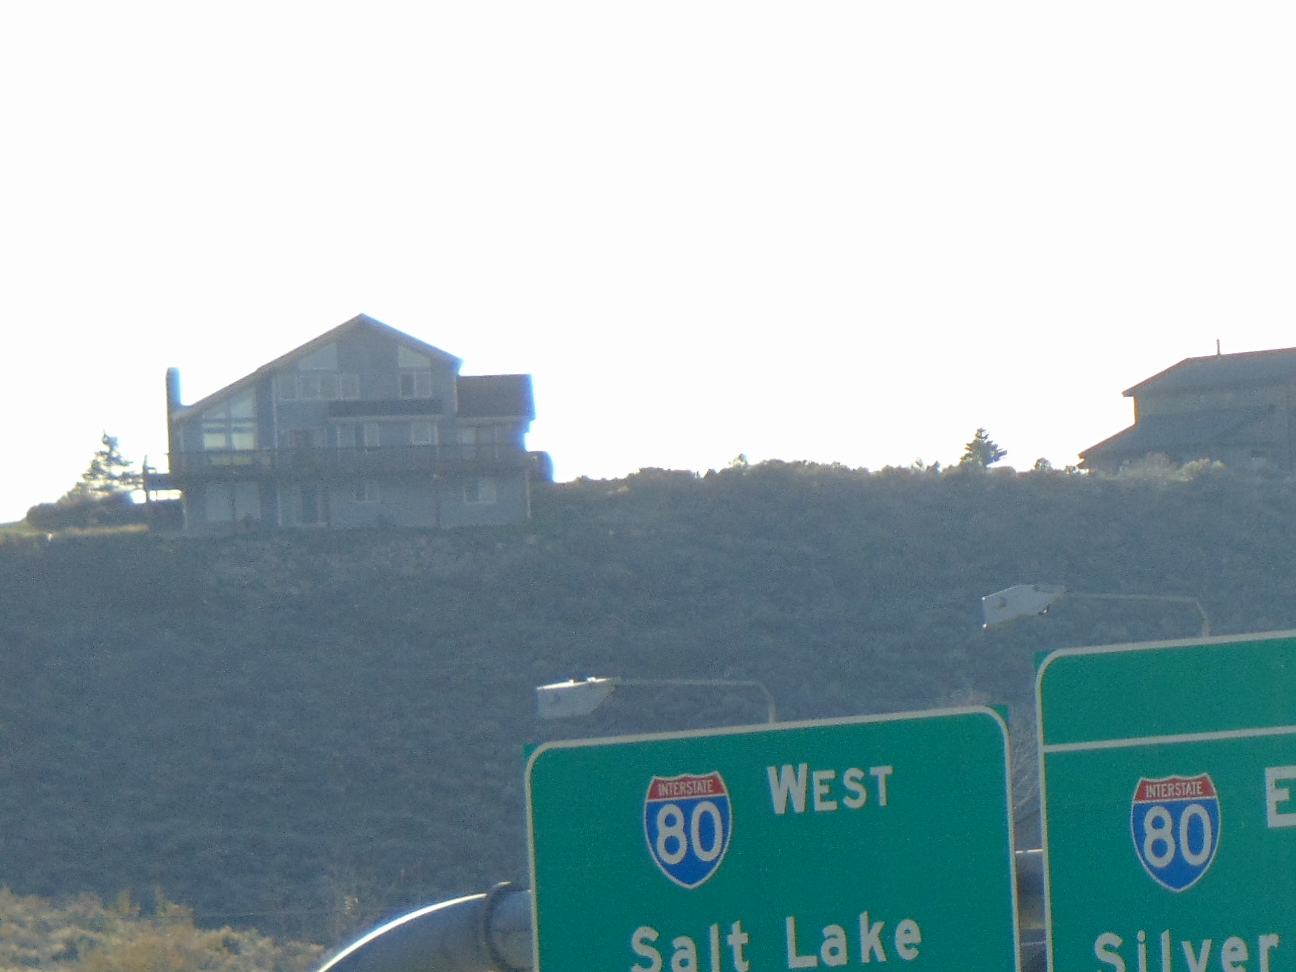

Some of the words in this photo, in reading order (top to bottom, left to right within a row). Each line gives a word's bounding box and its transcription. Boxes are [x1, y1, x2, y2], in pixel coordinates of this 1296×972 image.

[657, 778, 715, 797] INTERSTATE
[767, 763, 894, 815] WEST
[1144, 781, 1204, 798] INTERSTATE
[656, 801, 723, 865] 80
[1142, 804, 1213, 869] 80
[786, 911, 922, 970] Lake
